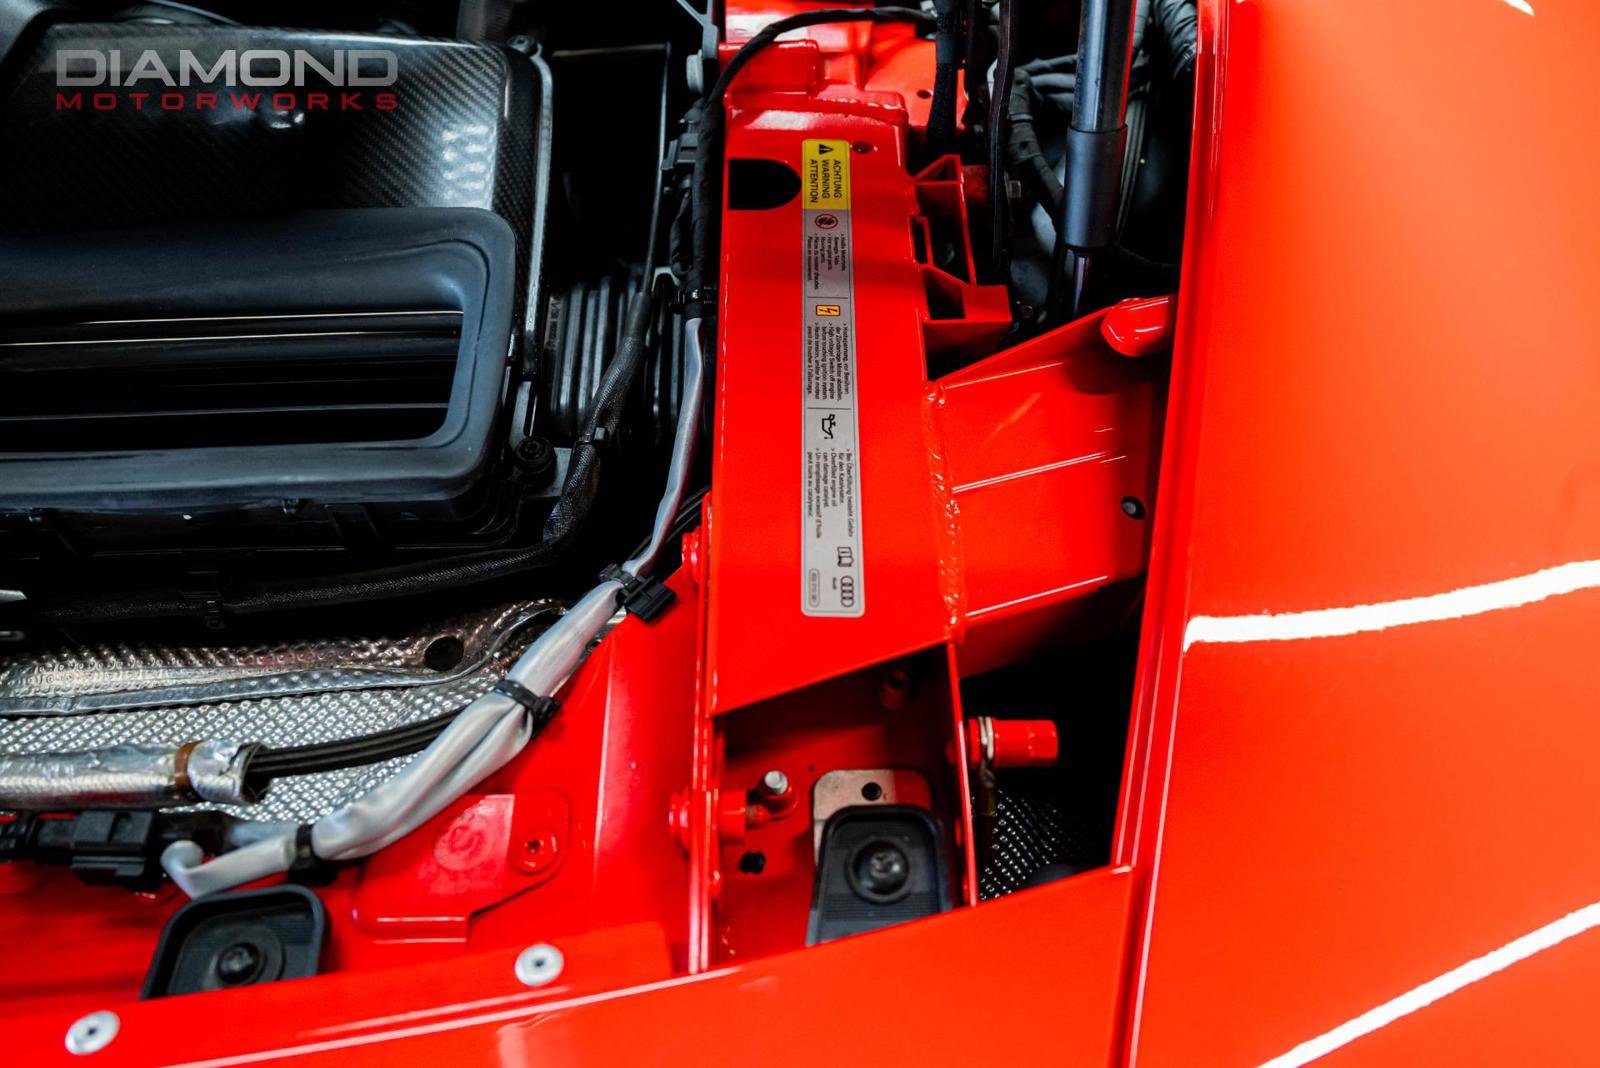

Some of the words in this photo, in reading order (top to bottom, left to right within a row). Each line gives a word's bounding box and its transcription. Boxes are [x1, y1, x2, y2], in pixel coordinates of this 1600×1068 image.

[810, 160, 819, 203] ATTENTION
[822, 160, 831, 199] WARNING
[833, 160, 842, 198] ACHTUNG
